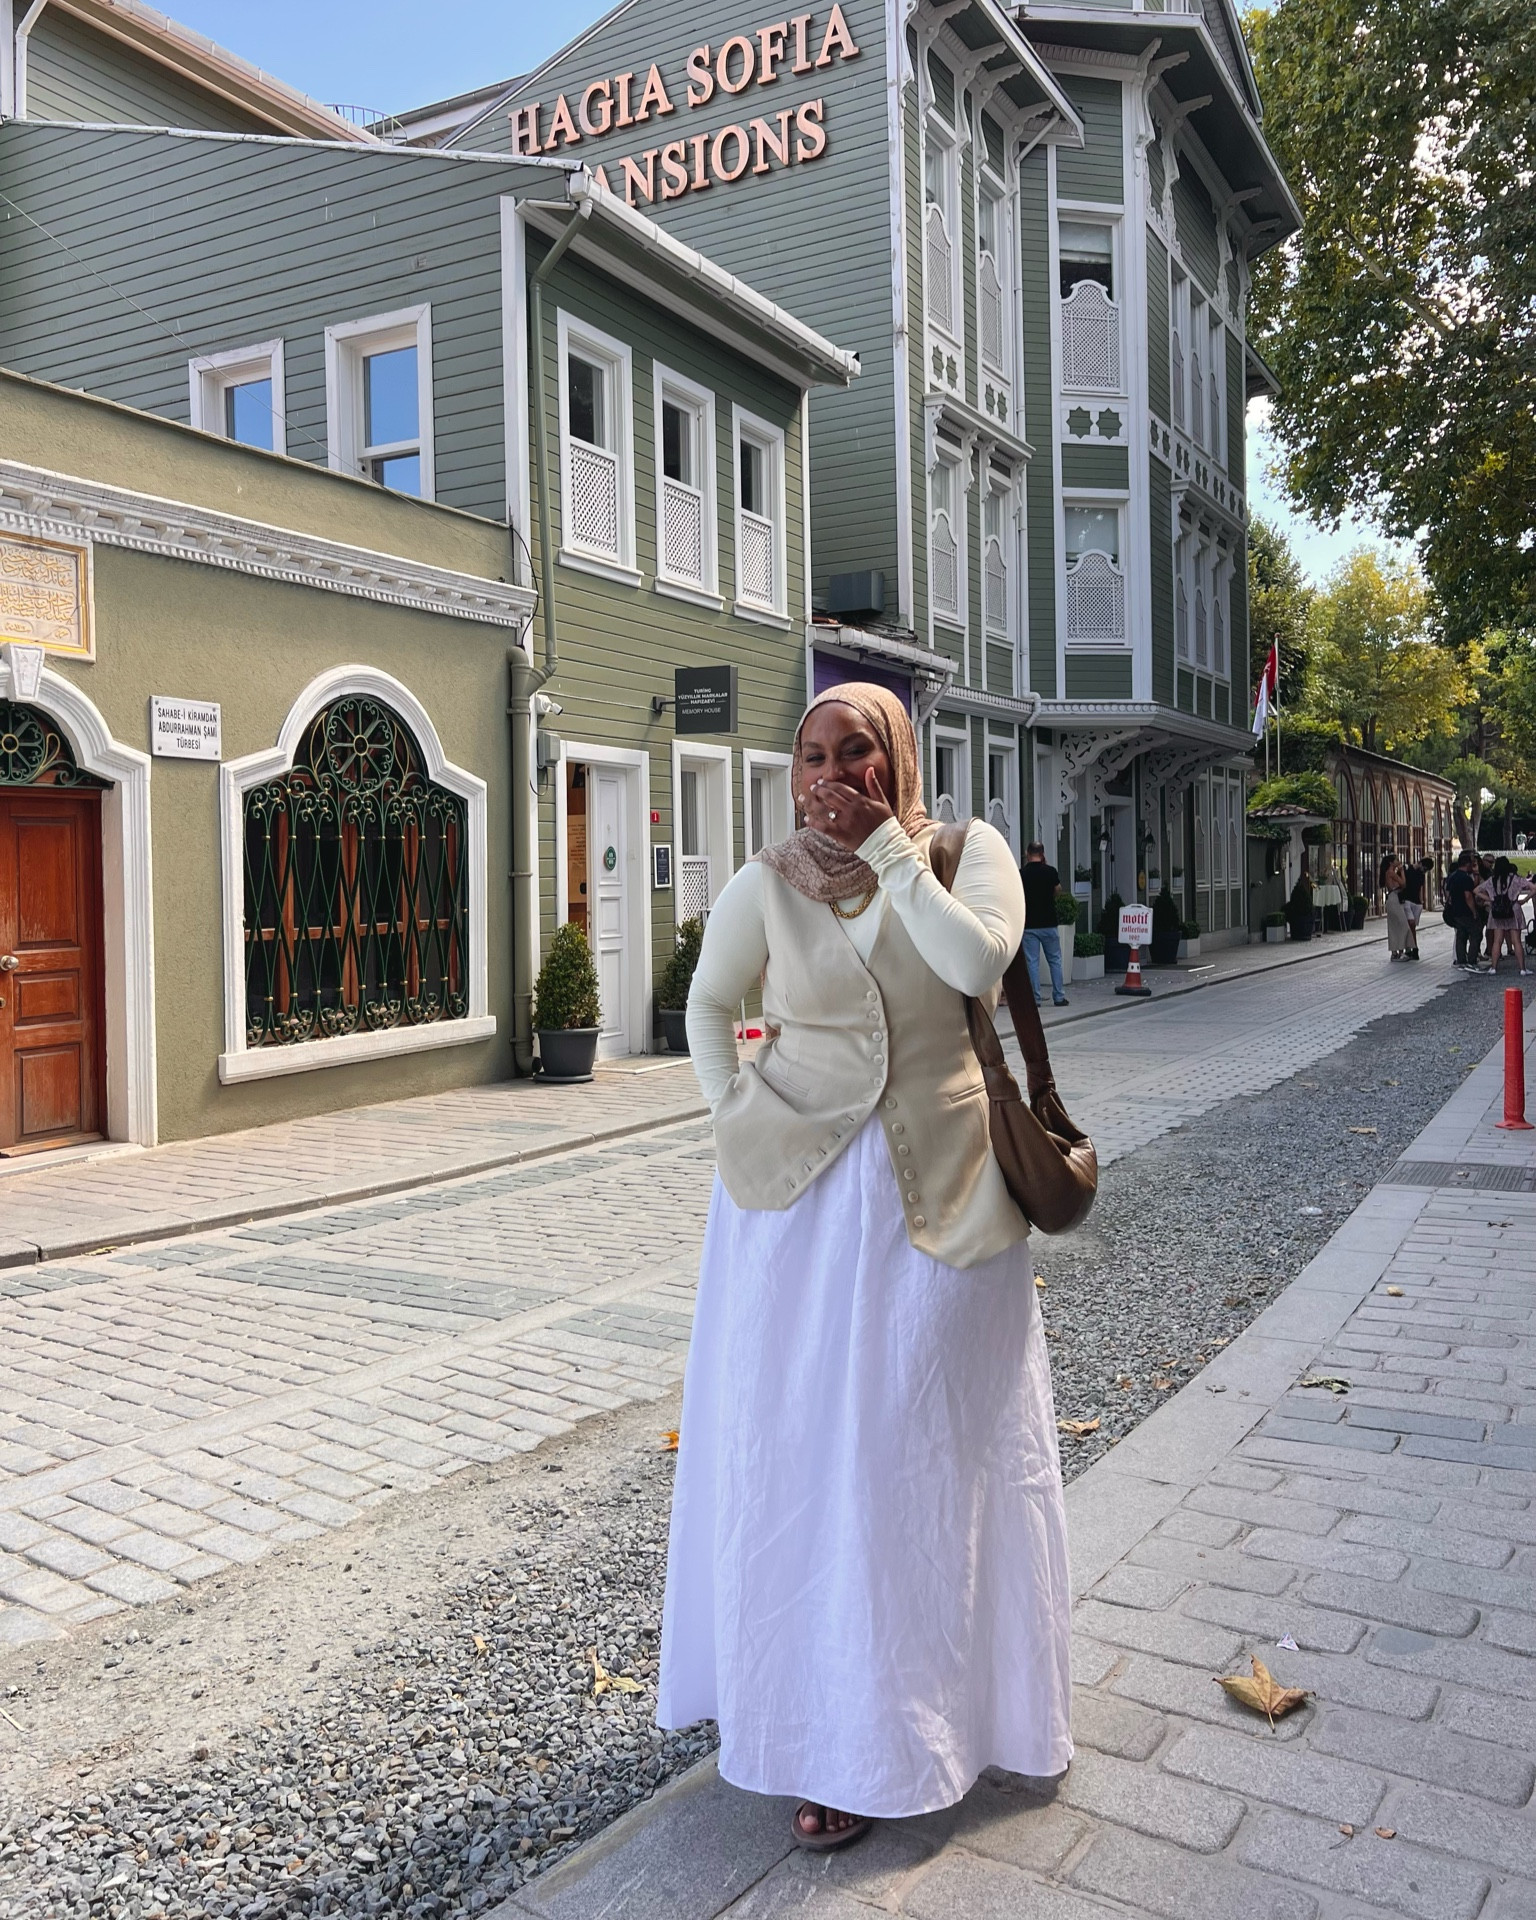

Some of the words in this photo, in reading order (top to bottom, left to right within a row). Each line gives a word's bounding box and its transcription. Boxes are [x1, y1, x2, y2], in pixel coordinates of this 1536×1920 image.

[508, 63, 674, 155] HAGIA
[687, 3, 859, 107] SOFIA
[159, 721, 201, 736] ABDURRAHMAN
[177, 737, 201, 750] TÜRBESİ
[1122, 912, 1149, 924] motif
